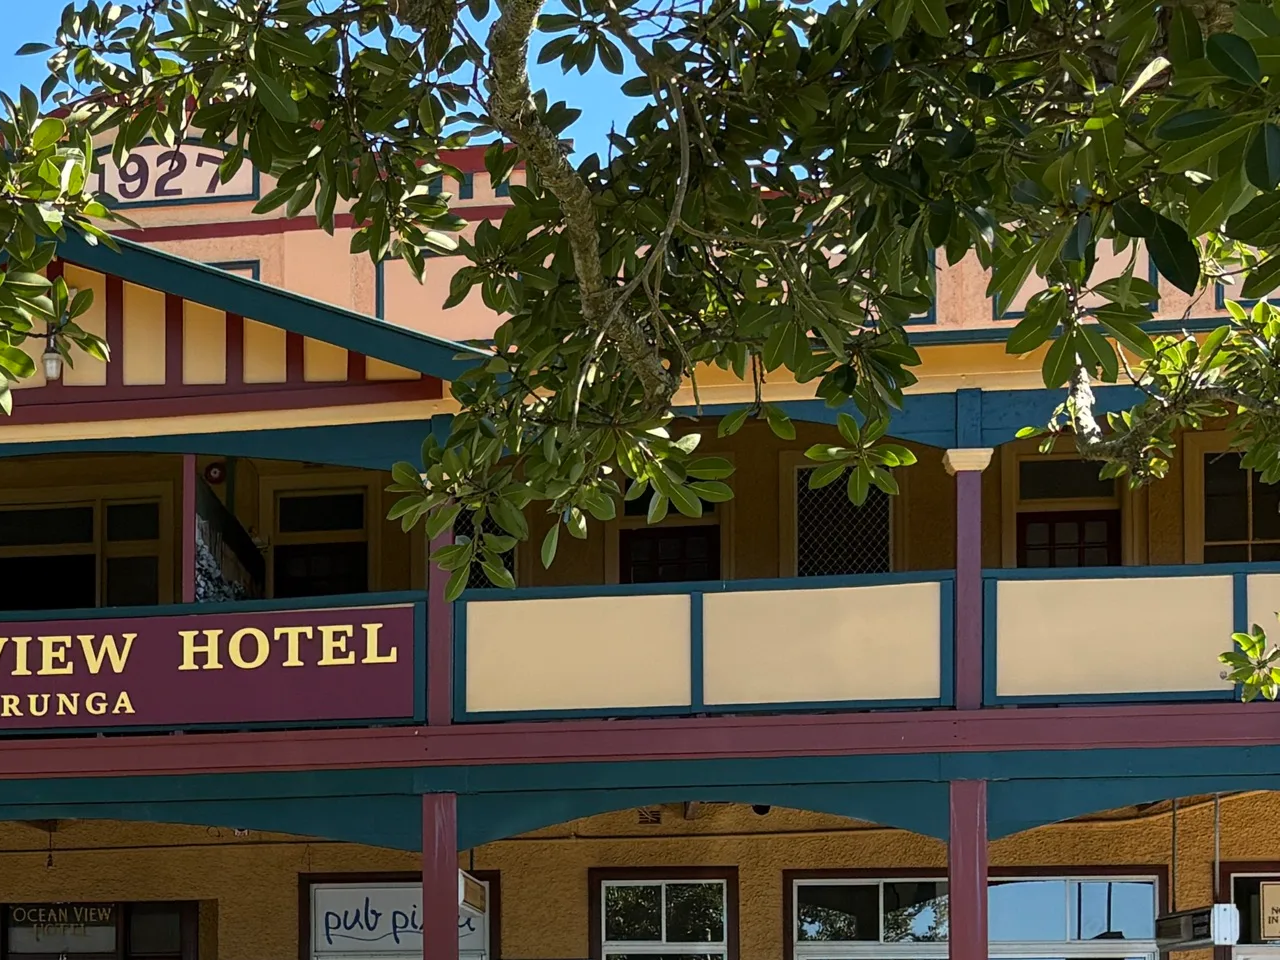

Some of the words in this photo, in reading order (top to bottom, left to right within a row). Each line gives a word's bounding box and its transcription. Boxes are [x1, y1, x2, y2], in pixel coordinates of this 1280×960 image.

[178, 622, 399, 671] HOTEL
[12, 907, 68, 922] OCEAN
[73, 906, 111, 922] VIEW
[324, 897, 382, 945] pub
